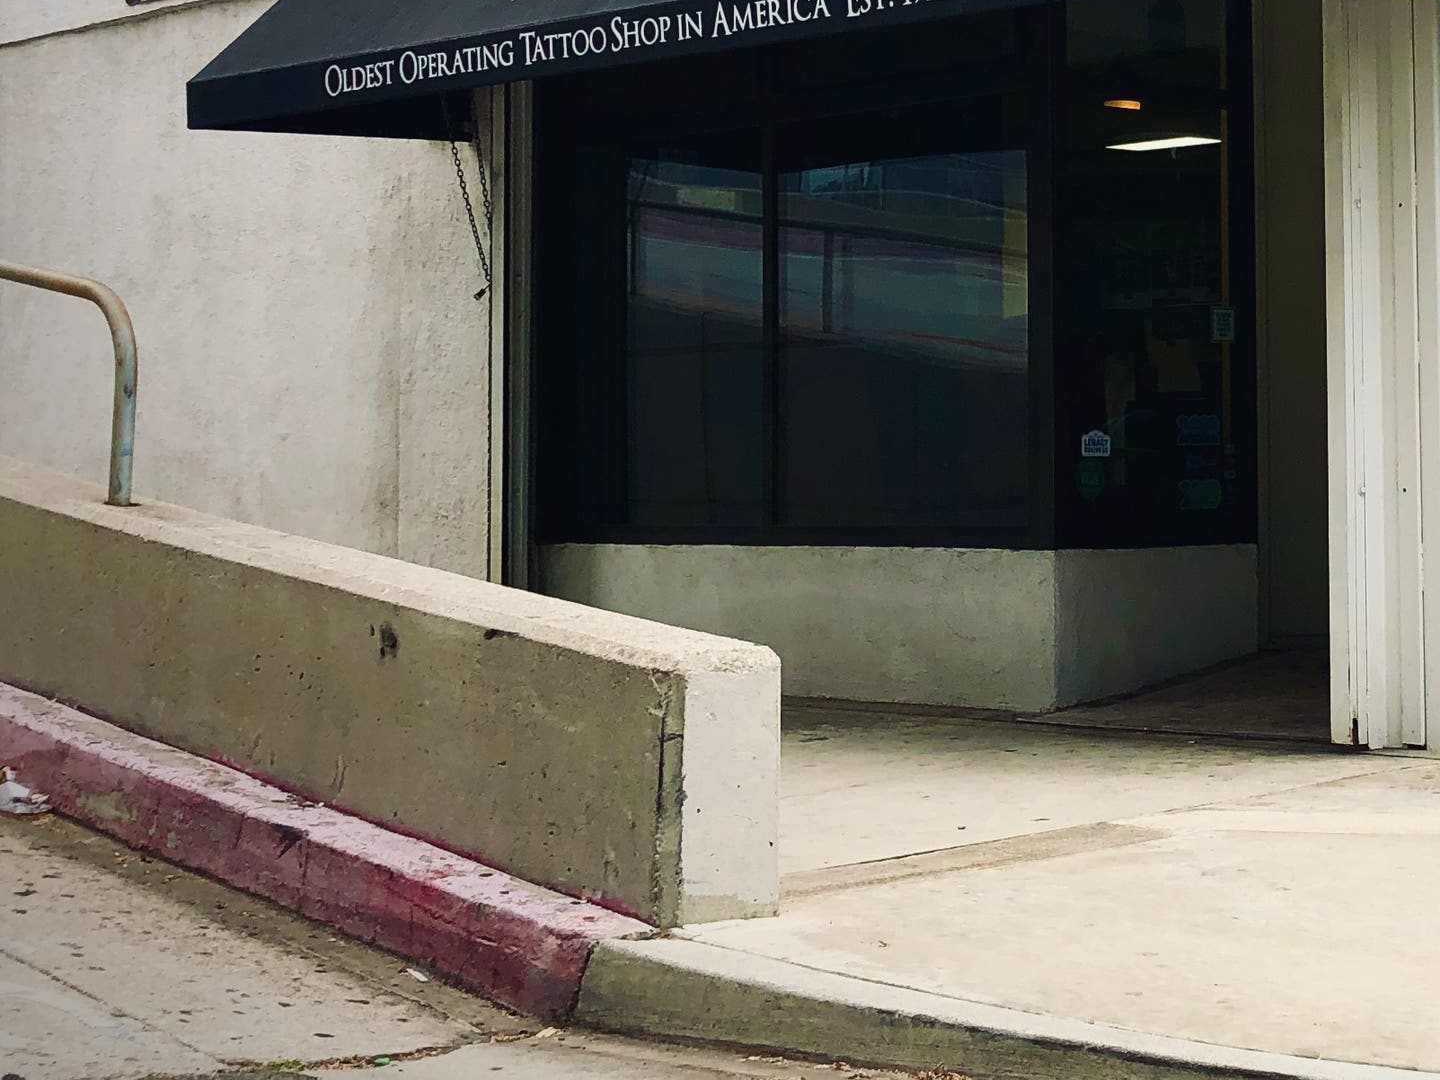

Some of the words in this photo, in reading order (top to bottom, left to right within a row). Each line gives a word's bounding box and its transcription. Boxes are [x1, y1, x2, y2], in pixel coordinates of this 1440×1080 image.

[325, 60, 394, 97] OLDEST
[400, 41, 514, 84] OPERATING
[519, 26, 607, 66] TATTOO
[611, 16, 671, 52] SHOP
[678, 11, 703, 41] IN
